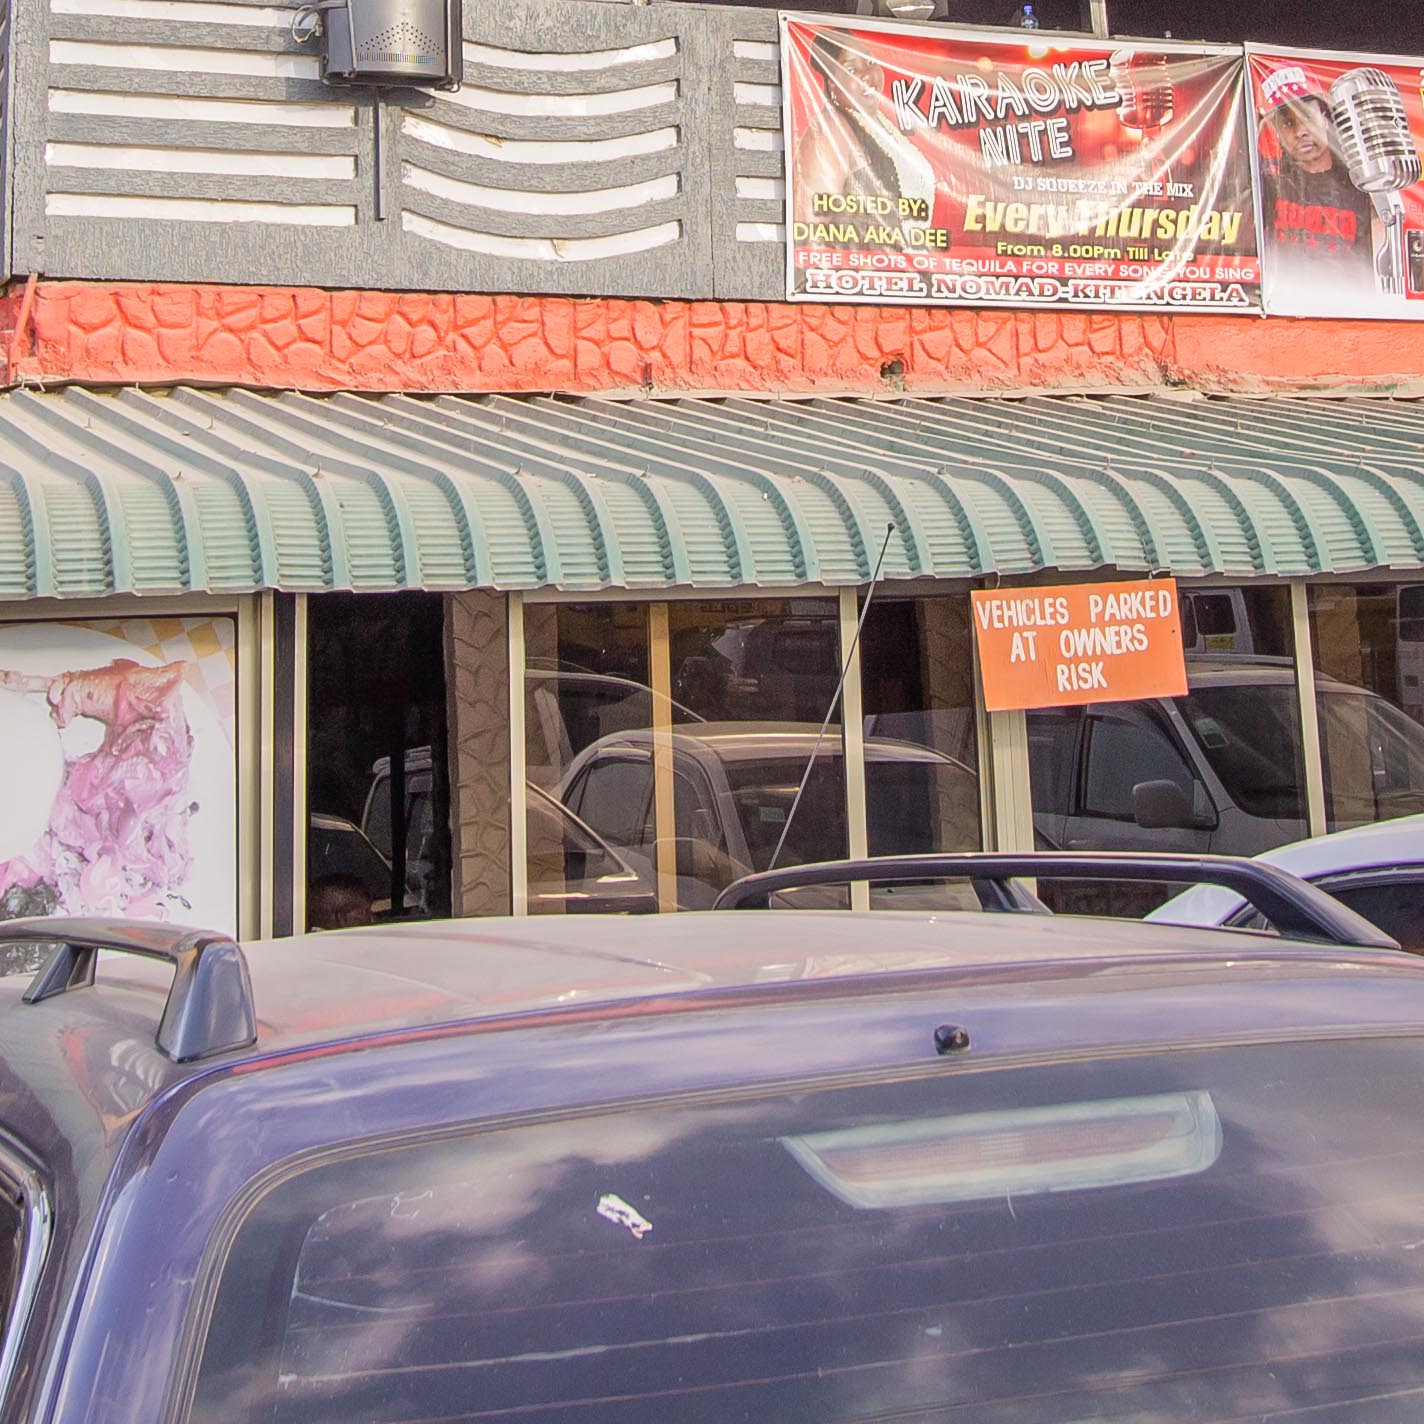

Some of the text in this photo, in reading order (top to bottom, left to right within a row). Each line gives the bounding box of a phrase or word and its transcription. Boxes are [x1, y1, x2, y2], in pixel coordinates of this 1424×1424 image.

[892, 59, 1122, 132] KARAOKE
[979, 118, 1073, 168] NITE
[1014, 176, 1194, 197] DJ SQUEEZE IN THE MIX
[813, 194, 927, 217] HOSTED BY:
[963, 194, 1070, 239] Every
[1075, 198, 1242, 244] Thursday
[793, 222, 948, 248] DIANA AKA DEE
[799, 251, 842, 266] FREE
[849, 253, 906, 268] SHOTS
[913, 256, 937, 269] OF
[944, 257, 1017, 273] TEQUILA
[1023, 260, 1059, 274] FOR
[1064, 262, 1114, 276] EVERY
[1176, 266, 1212, 279] YOU
[1216, 267, 1255, 280] SING
[996, 242, 1045, 257] From
[1051, 243, 1121, 260] 8.00Pm
[807, 270, 926, 295] HOTEL
[976, 589, 1171, 630] VEHICLES PARKED
[1010, 624, 1149, 663] AT OWNERS
[1056, 661, 1107, 692] RISK
